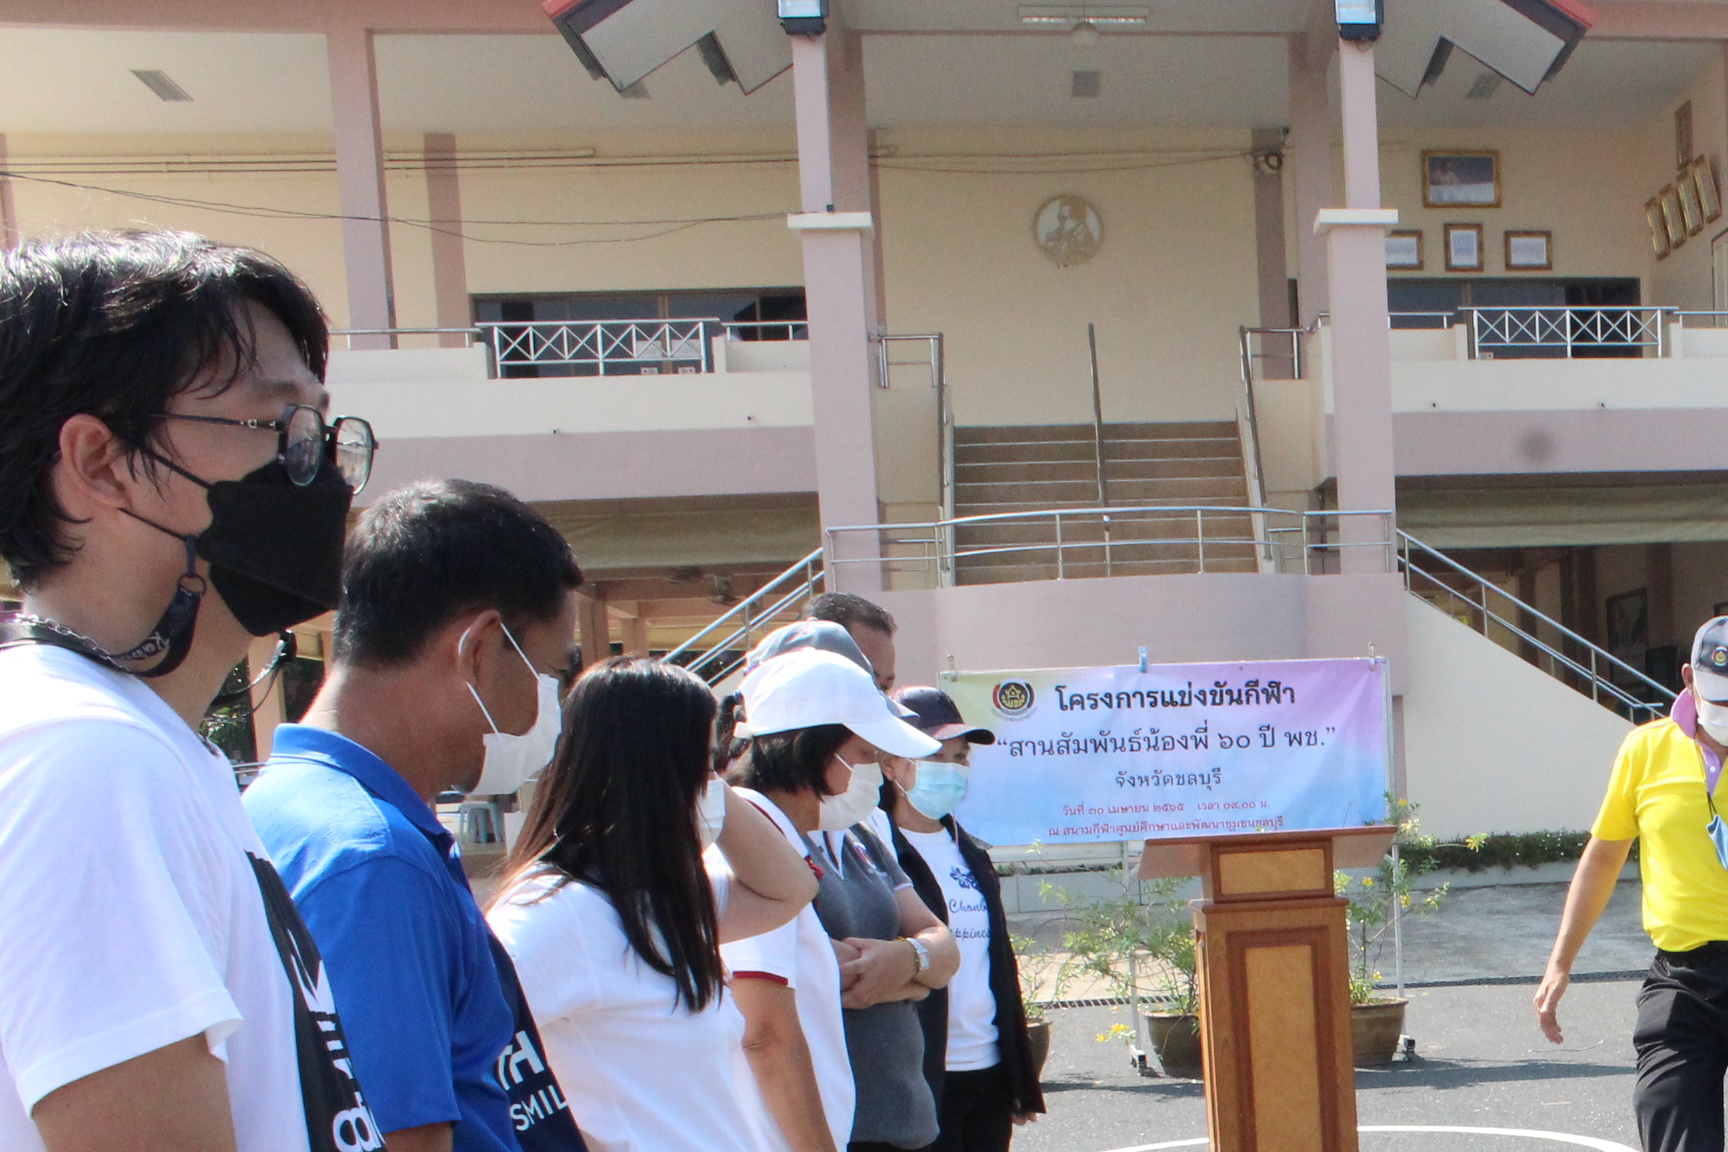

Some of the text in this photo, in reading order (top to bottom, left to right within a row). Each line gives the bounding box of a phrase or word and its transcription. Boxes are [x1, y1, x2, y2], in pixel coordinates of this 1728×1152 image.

[1055, 679, 1295, 711] โครงการแข่งขันกีฬา
[997, 720, 1336, 757] “สานสัมพันธ์น้องพี่ ๖๐ ปี พช.”
[1116, 768, 1222, 791] จังหวัดชลบุรี
[1063, 801, 1085, 816] วันที่
[1108, 804, 1149, 814] เมษายน
[1197, 801, 1220, 811] เวลา
[1048, 827, 1060, 836] ณ
[510, 1084, 568, 1131] SMIL
